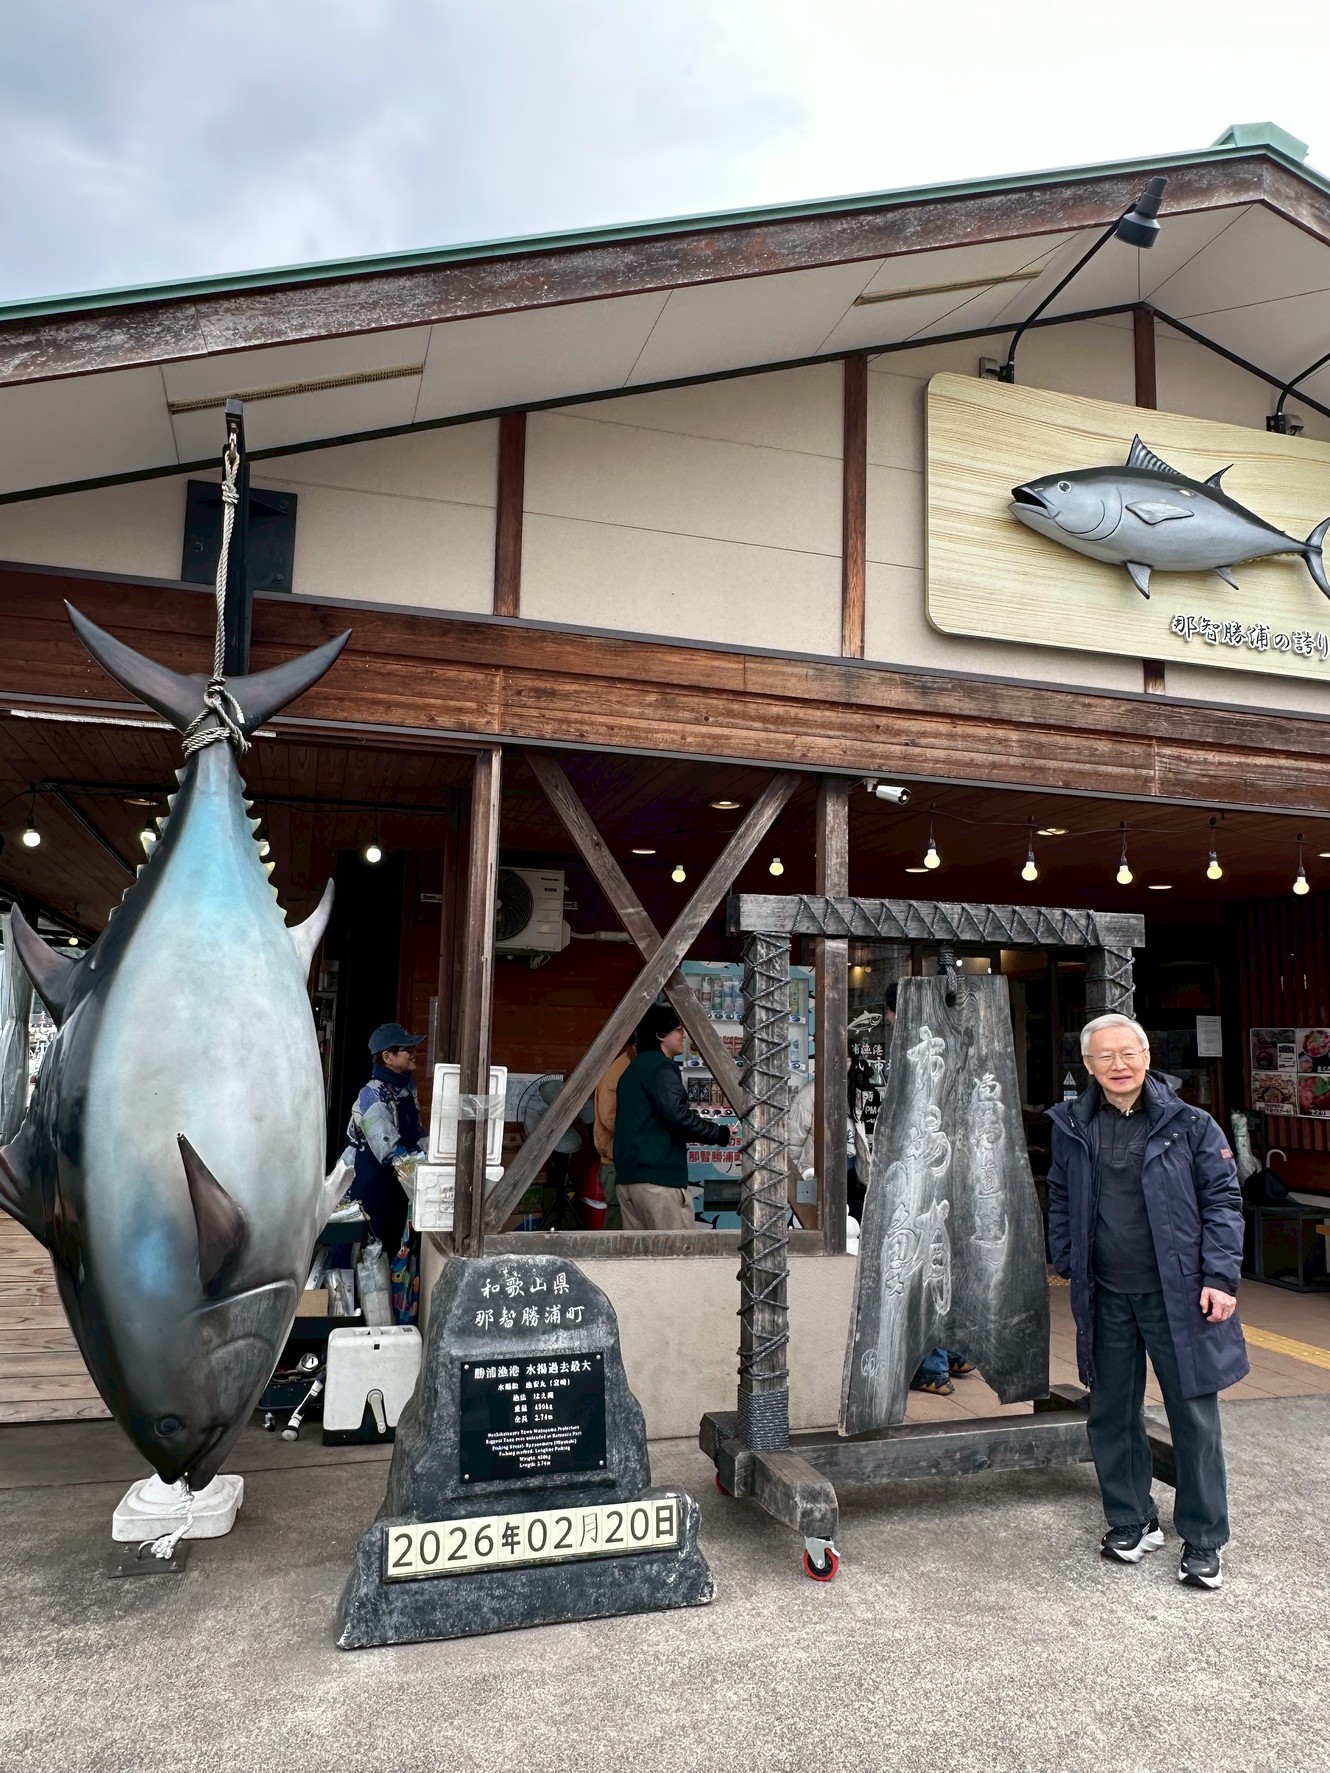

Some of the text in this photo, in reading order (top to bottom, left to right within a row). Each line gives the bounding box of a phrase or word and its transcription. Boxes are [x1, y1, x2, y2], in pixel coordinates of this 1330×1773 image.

[1172, 615, 1329, 659] 那智勝浦の誇り
[480, 1272, 570, 1299] 和歌山県
[474, 1304, 585, 1330] 那智勝浦町
[474, 1359, 592, 1379] 勝浦漁港 水揚過去最大
[392, 1505, 675, 1569] 2026年02月20日
